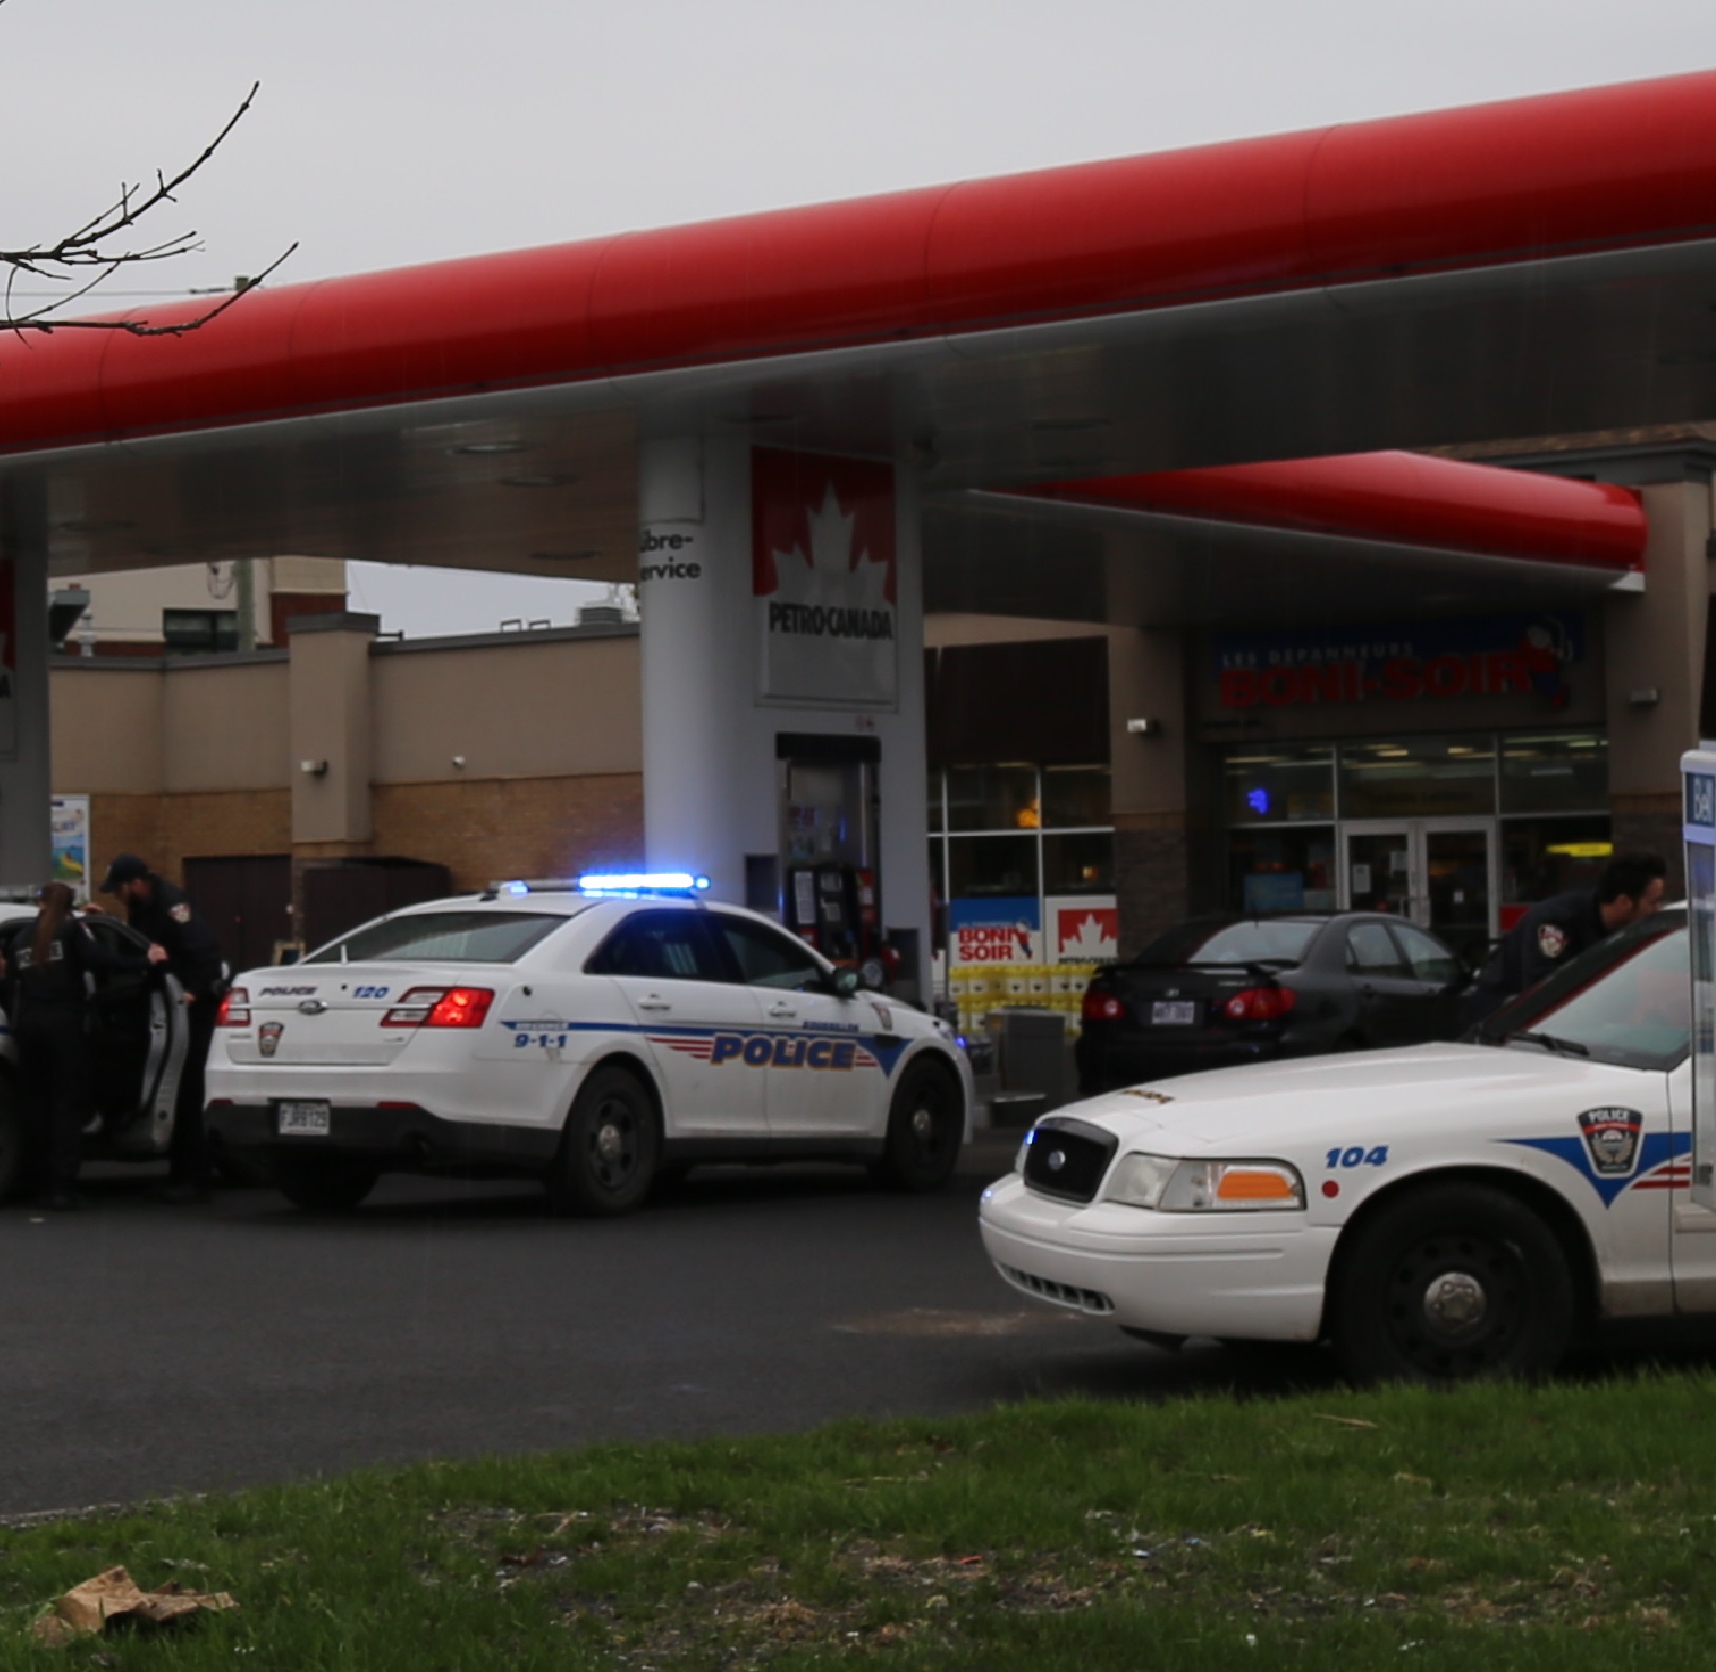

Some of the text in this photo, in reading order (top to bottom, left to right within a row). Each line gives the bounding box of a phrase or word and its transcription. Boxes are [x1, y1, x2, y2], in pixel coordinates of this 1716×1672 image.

[1219, 653, 1533, 709] BONI-SOIR
[959, 945, 1013, 961] SOIR
[515, 1034, 568, 1048] 9-1-1
[711, 1034, 857, 1073] POLICE
[1326, 1146, 1389, 1168] 104
